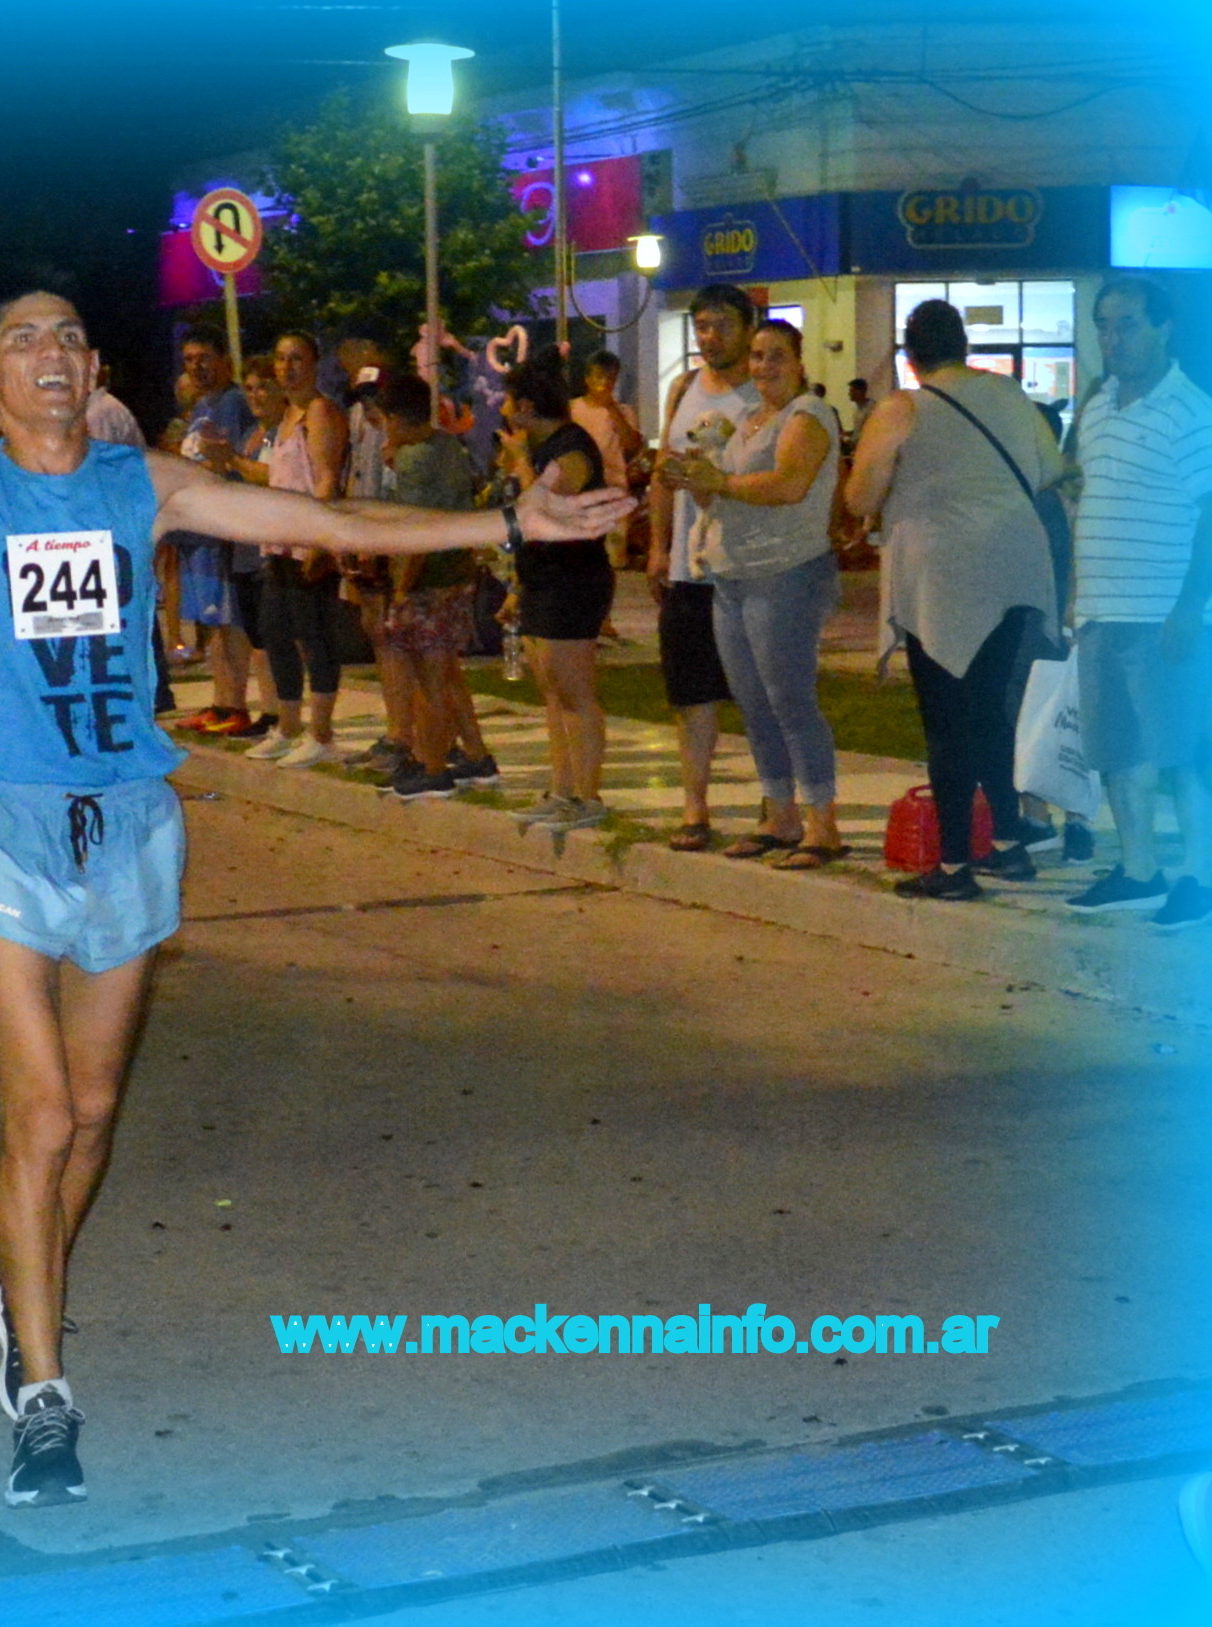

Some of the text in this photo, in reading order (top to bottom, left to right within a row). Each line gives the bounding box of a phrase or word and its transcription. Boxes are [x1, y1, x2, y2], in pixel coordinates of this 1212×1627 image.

[905, 196, 1035, 225] GRIDO
[703, 228, 756, 256] GRIDO
[26, 539, 91, 552] A tiempo
[19, 559, 107, 613] 244
[27, 624, 133, 688] VE
[39, 690, 135, 758] TE
